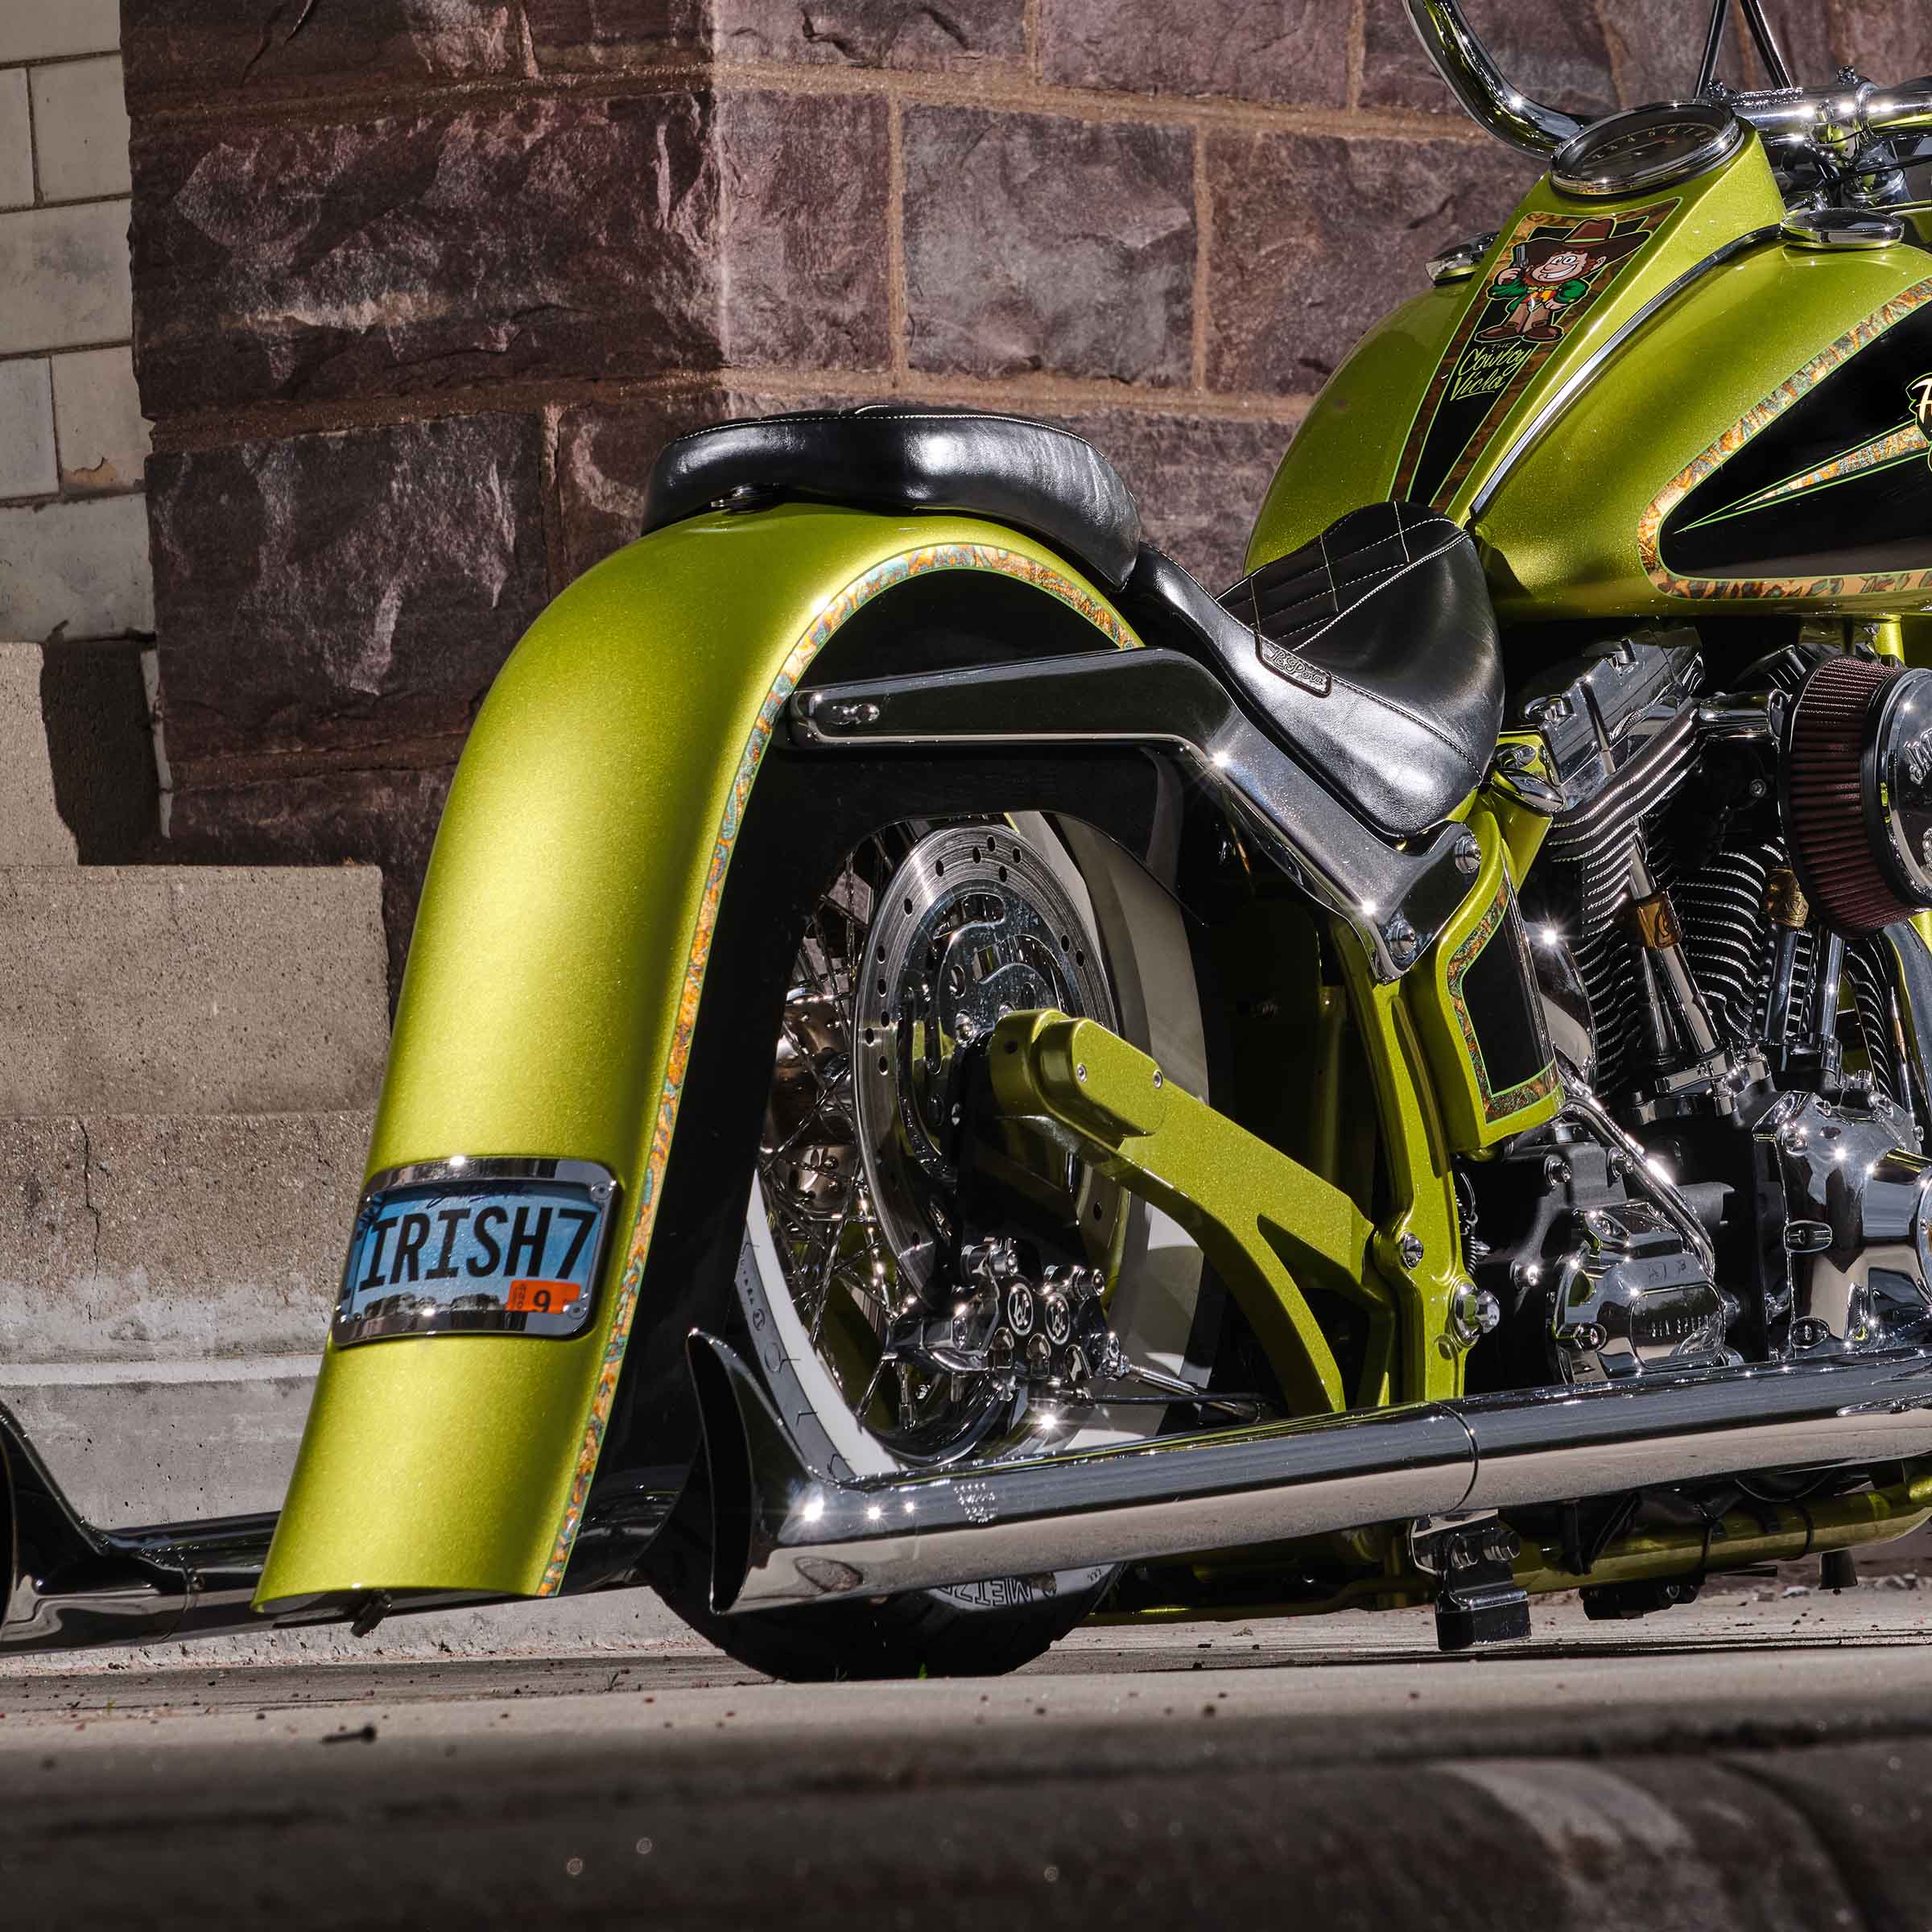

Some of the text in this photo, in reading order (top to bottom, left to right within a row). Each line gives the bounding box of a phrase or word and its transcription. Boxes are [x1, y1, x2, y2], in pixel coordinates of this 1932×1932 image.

[1458, 341, 1532, 377] Cowboy
[359, 1204, 597, 1293] IRISH7
[532, 1289, 551, 1313] 9
